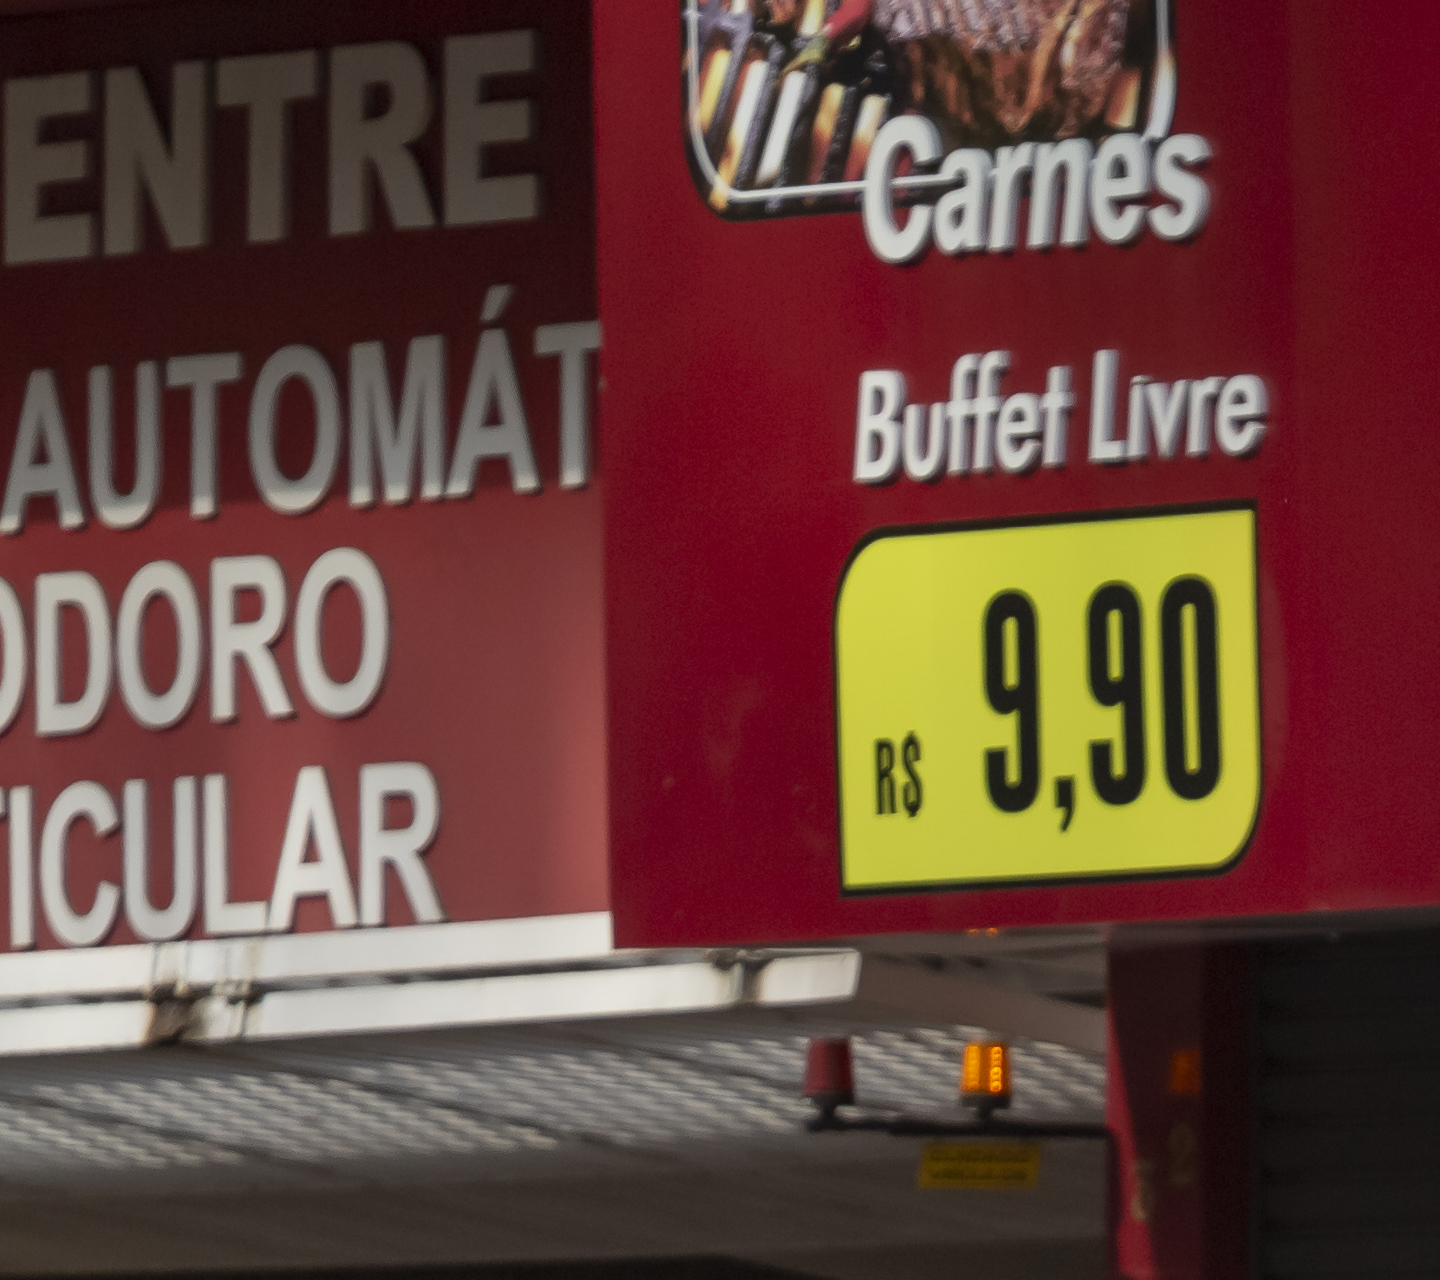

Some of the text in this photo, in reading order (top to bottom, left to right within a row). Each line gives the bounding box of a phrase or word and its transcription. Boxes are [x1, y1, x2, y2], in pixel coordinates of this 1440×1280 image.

[3, 28, 543, 266] ENTRE
[862, 114, 1211, 263] Carnes
[853, 351, 1268, 485] Buffet Livre
[874, 573, 1223, 832] R$ 9,90
